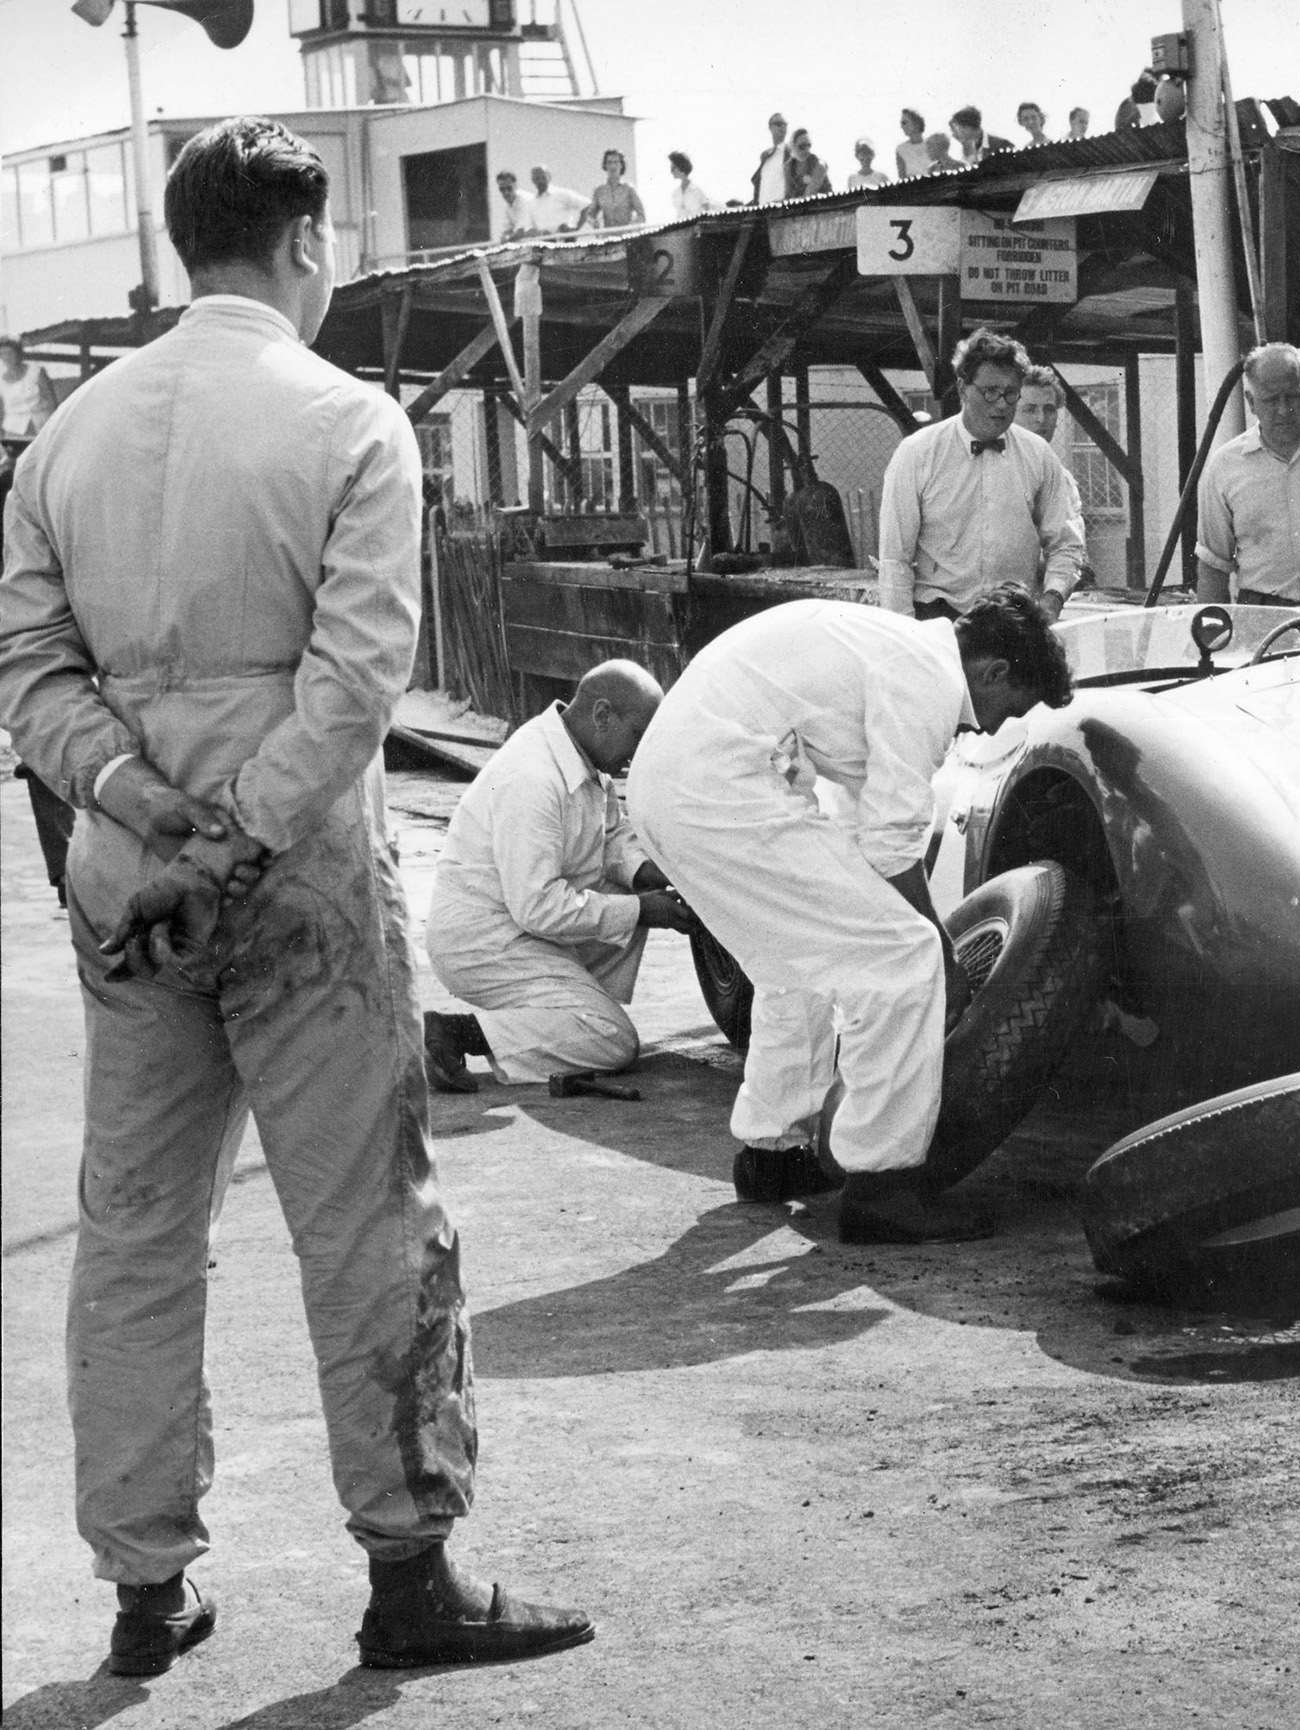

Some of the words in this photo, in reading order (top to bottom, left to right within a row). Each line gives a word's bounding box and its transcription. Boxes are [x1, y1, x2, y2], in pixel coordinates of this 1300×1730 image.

[888, 219, 914, 261] 3
[653, 249, 675, 286] 2
[1005, 268, 1036, 281] THROW
[1040, 270, 1069, 282] LITTER
[1006, 282, 1020, 294] PIT
[1024, 283, 1048, 295] ROAD
